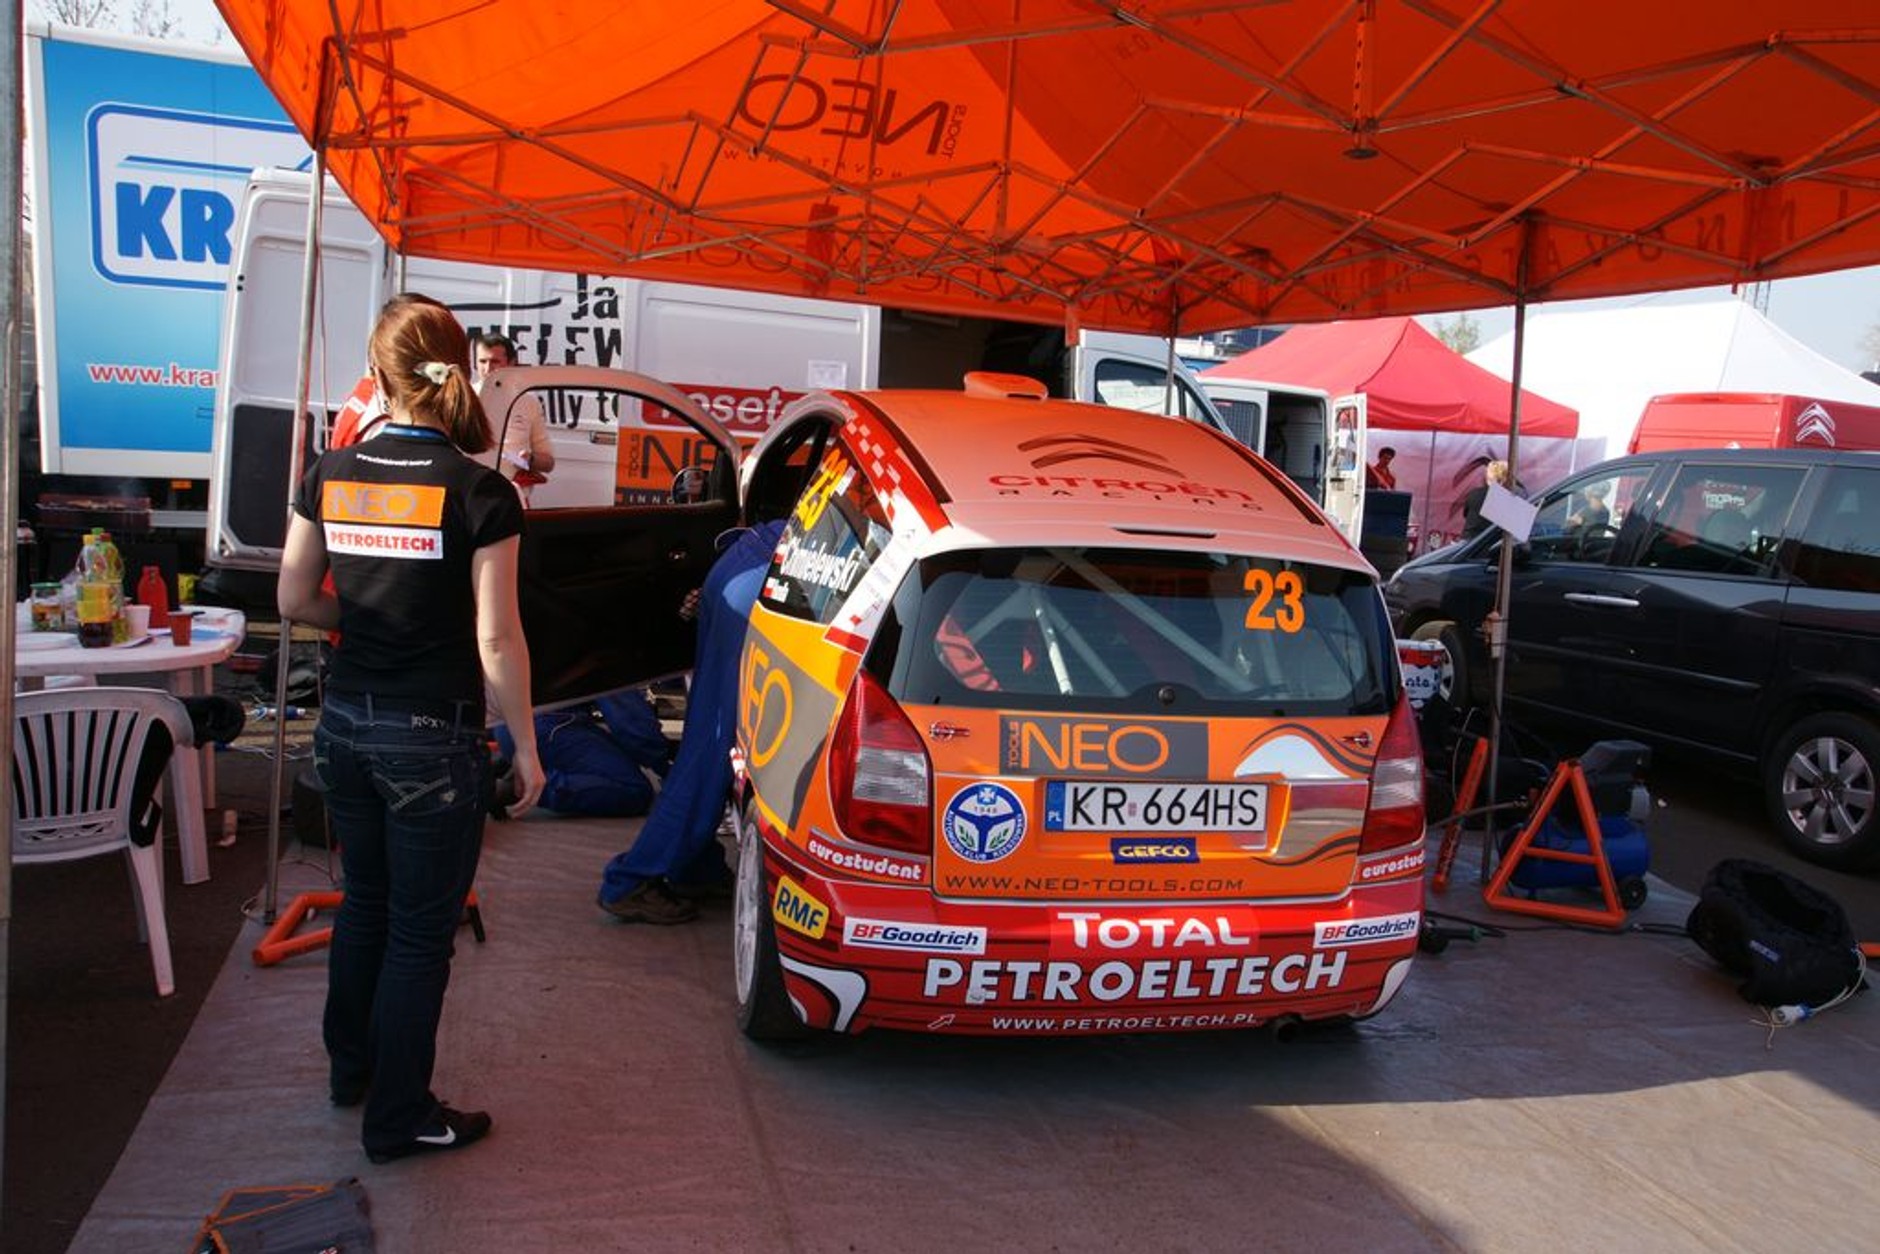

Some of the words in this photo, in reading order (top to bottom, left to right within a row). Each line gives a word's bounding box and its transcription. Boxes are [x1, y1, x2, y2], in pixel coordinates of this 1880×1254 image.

[88, 364, 221, 387] www.kra
[332, 486, 417, 519] NEO
[329, 531, 436, 552] PETROELTECH
[1244, 568, 1305, 633] 23
[1021, 721, 1170, 773] NEO
[1048, 810, 1063, 822] PL
[1071, 786, 1128, 826] KR
[1142, 787, 1259, 827] 664HS
[807, 838, 923, 882] eurostudent
[1118, 844, 1191, 859] GEFCO
[776, 886, 824, 932] RMF
[851, 923, 979, 948] BFGoodrich
[1057, 911, 1251, 949] TOTAL
[1321, 917, 1417, 941] BFGoodrich
[922, 950, 1348, 1006] PETROELTECH
[991, 1012, 1257, 1030] WWW.PETROELTECH.PL
